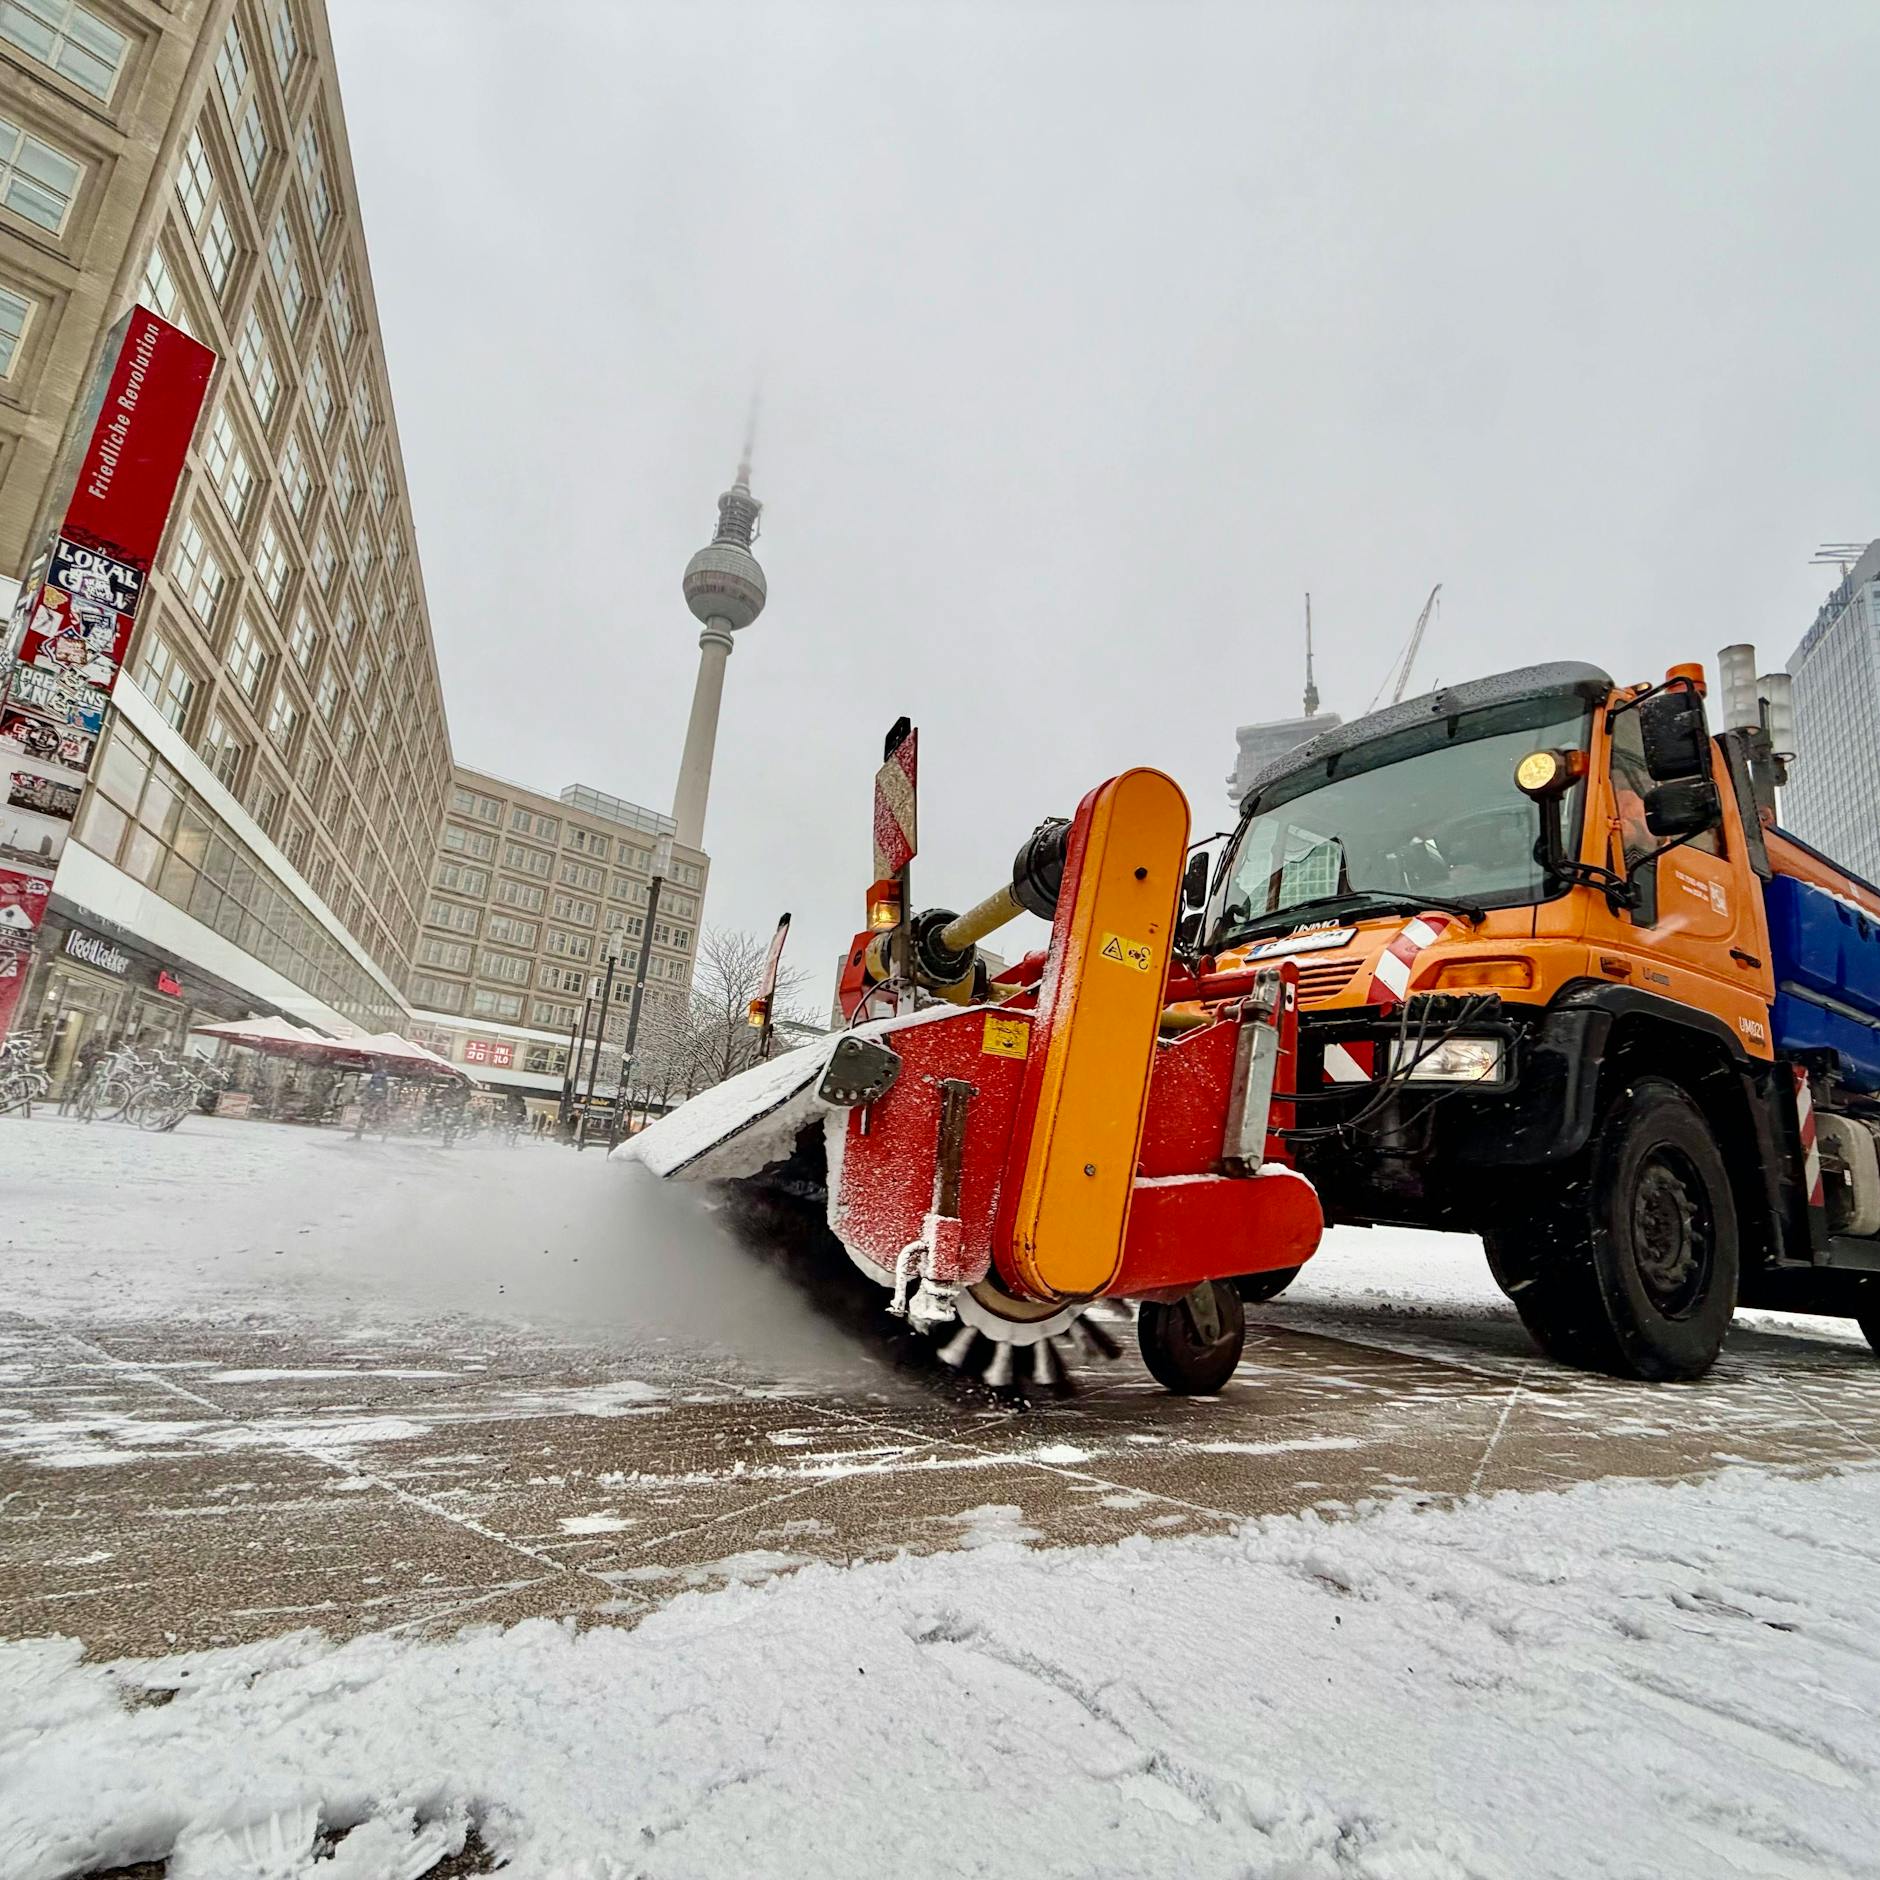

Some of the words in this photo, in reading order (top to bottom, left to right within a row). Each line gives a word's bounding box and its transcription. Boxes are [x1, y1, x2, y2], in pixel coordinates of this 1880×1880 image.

[89, 413, 131, 500] Friedliche
[117, 322, 160, 411] Revolution
[57, 541, 140, 590] LOKAL
